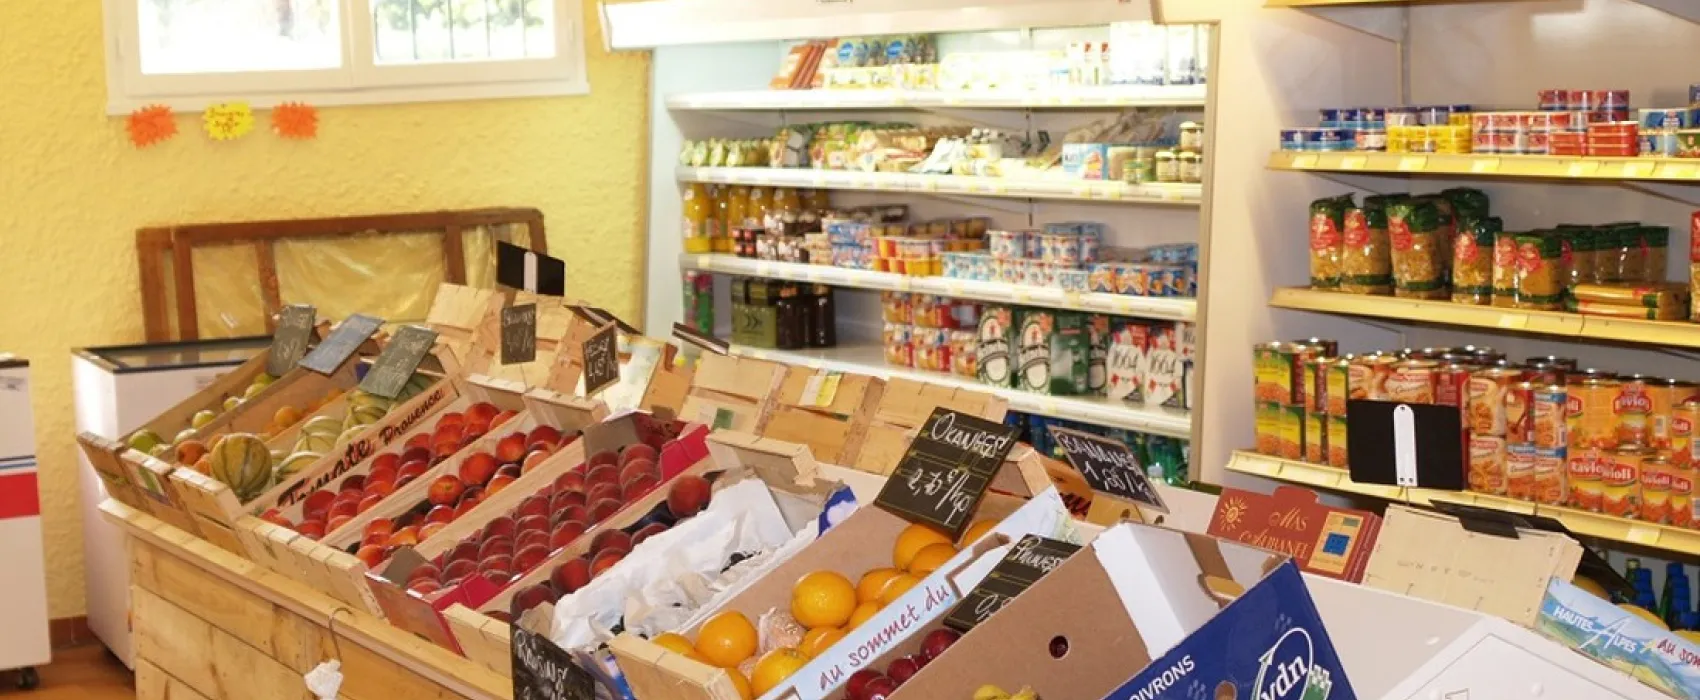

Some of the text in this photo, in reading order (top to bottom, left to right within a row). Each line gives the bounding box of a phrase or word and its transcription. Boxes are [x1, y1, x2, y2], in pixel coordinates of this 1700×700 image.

[847, 604, 921, 669] sommet
[924, 585, 951, 612] du
[1551, 605, 1595, 631] HAUTES
